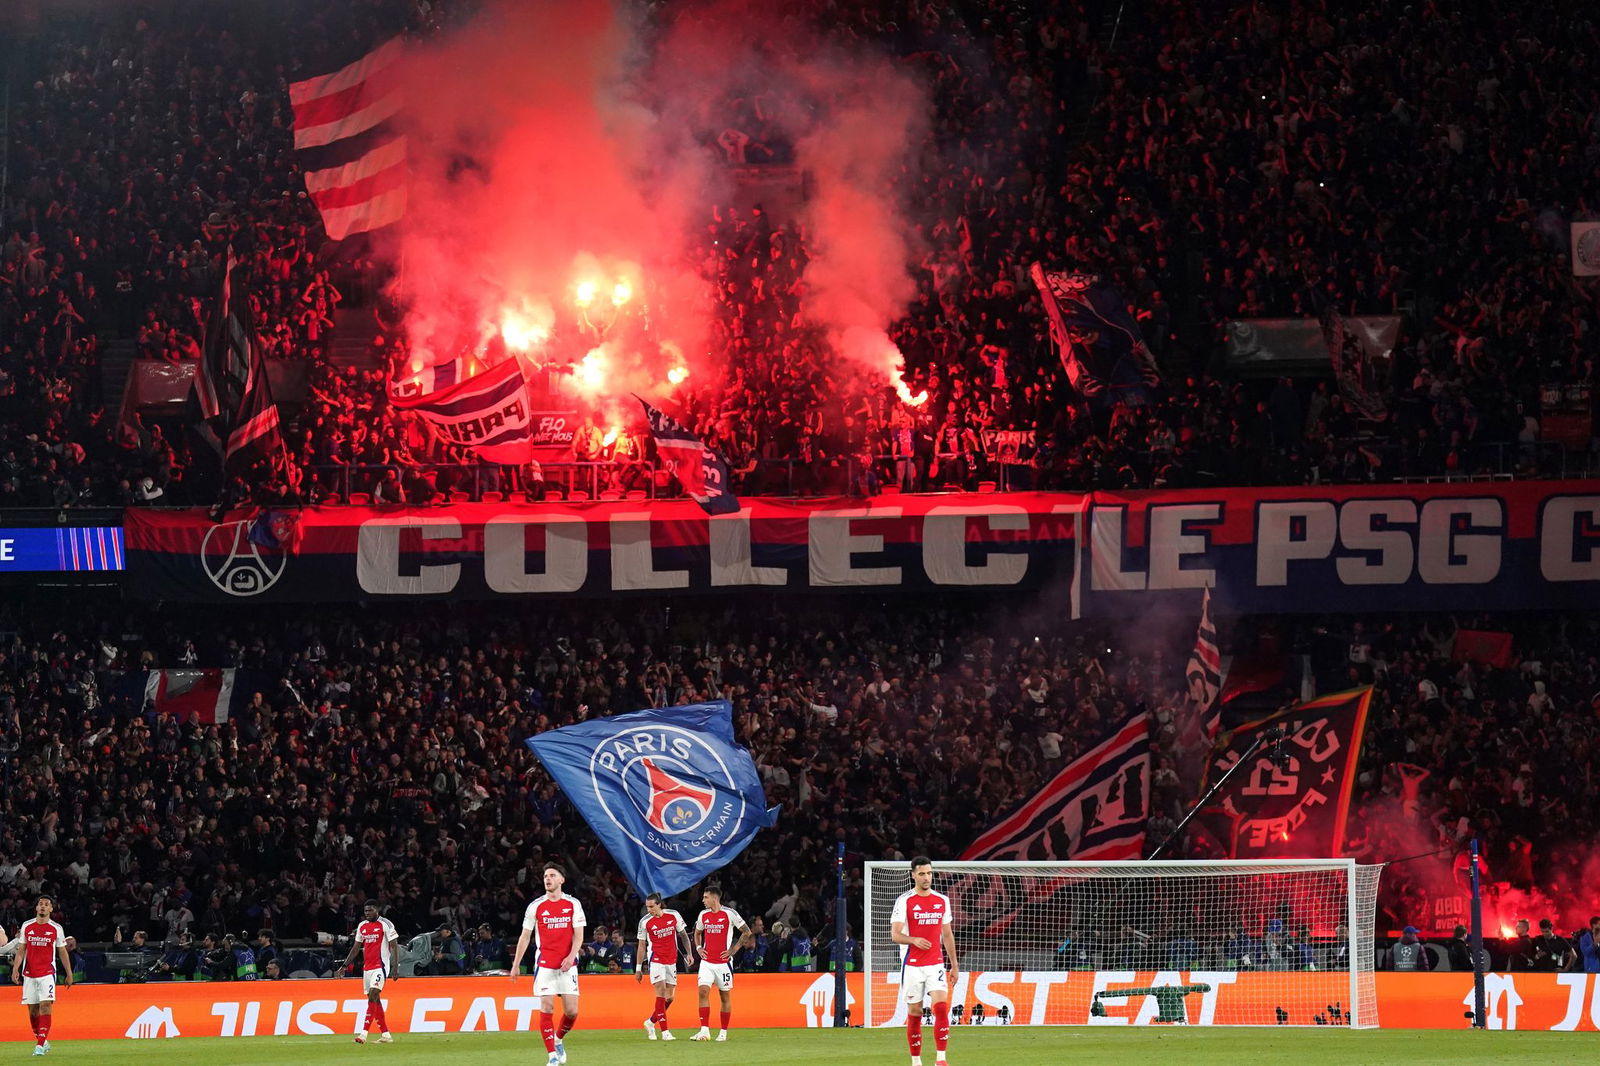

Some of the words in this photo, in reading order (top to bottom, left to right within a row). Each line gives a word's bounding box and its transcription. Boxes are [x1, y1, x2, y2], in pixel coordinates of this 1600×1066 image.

[540, 417, 566, 432] FLO
[551, 431, 573, 443] NOUS
[984, 431, 1037, 448] PARIS
[1091, 502, 1220, 591] LE
[1256, 498, 1503, 587] PSG
[598, 731, 692, 774] PARIS
[647, 831, 680, 853] SAINT
[691, 801, 733, 848] GERMAIN
[543, 916, 571, 924] Emirates
[914, 912, 943, 920] Emirates
[653, 926, 675, 936] Emirates
[28, 935, 52, 943] Emirates
[375, 974, 382, 983] 5
[722, 972, 731, 983] 15
[48, 984, 54, 994] 2
[1088, 971, 1237, 1027] EAT
